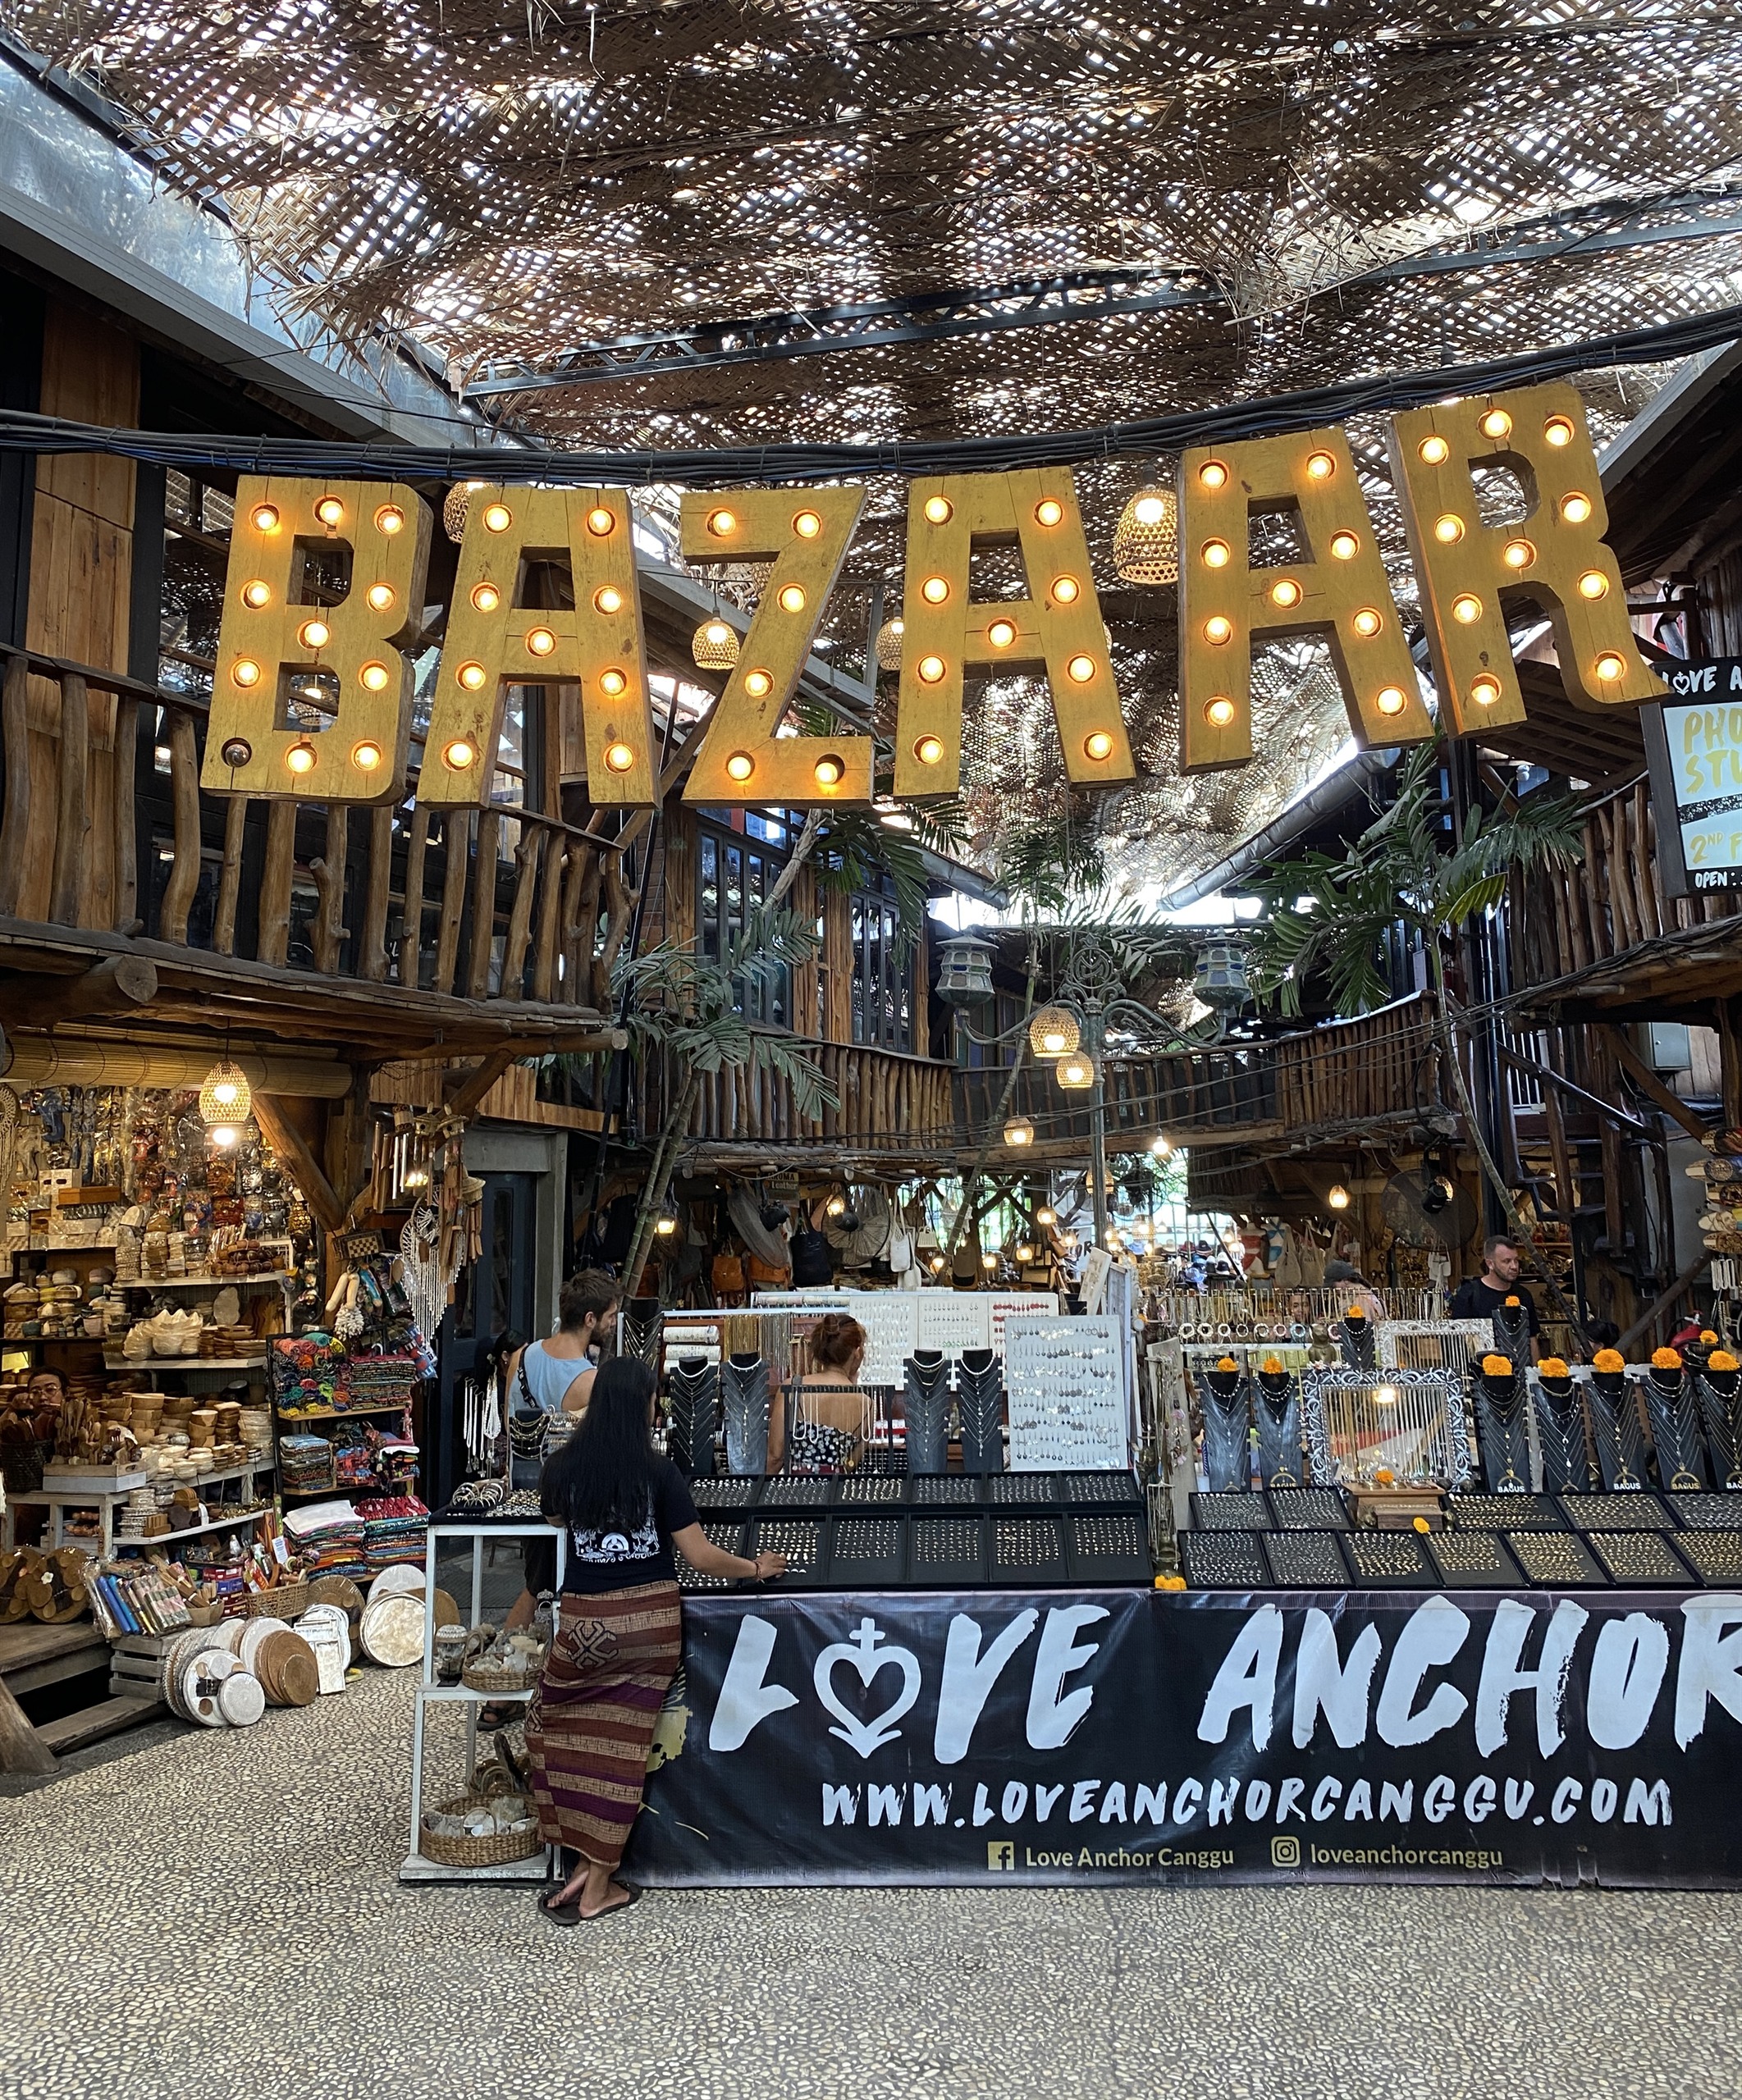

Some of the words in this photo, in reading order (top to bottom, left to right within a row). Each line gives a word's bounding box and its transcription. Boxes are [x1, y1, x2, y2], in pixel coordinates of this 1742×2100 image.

[200, 382, 1671, 810] BAZAAR
[1690, 832, 1723, 865] 2ND
[1197, 1595, 1742, 1760] ANCHOR
[822, 1774, 1673, 1828] WWW.LOVEANCHORCANGGU.COM
[1026, 1847, 1073, 1867] Love
[1077, 1847, 1154, 1867] Anchor
[1157, 1847, 1234, 1869] Canggu
[1310, 1844, 1503, 1870] loveanchorcanggu
